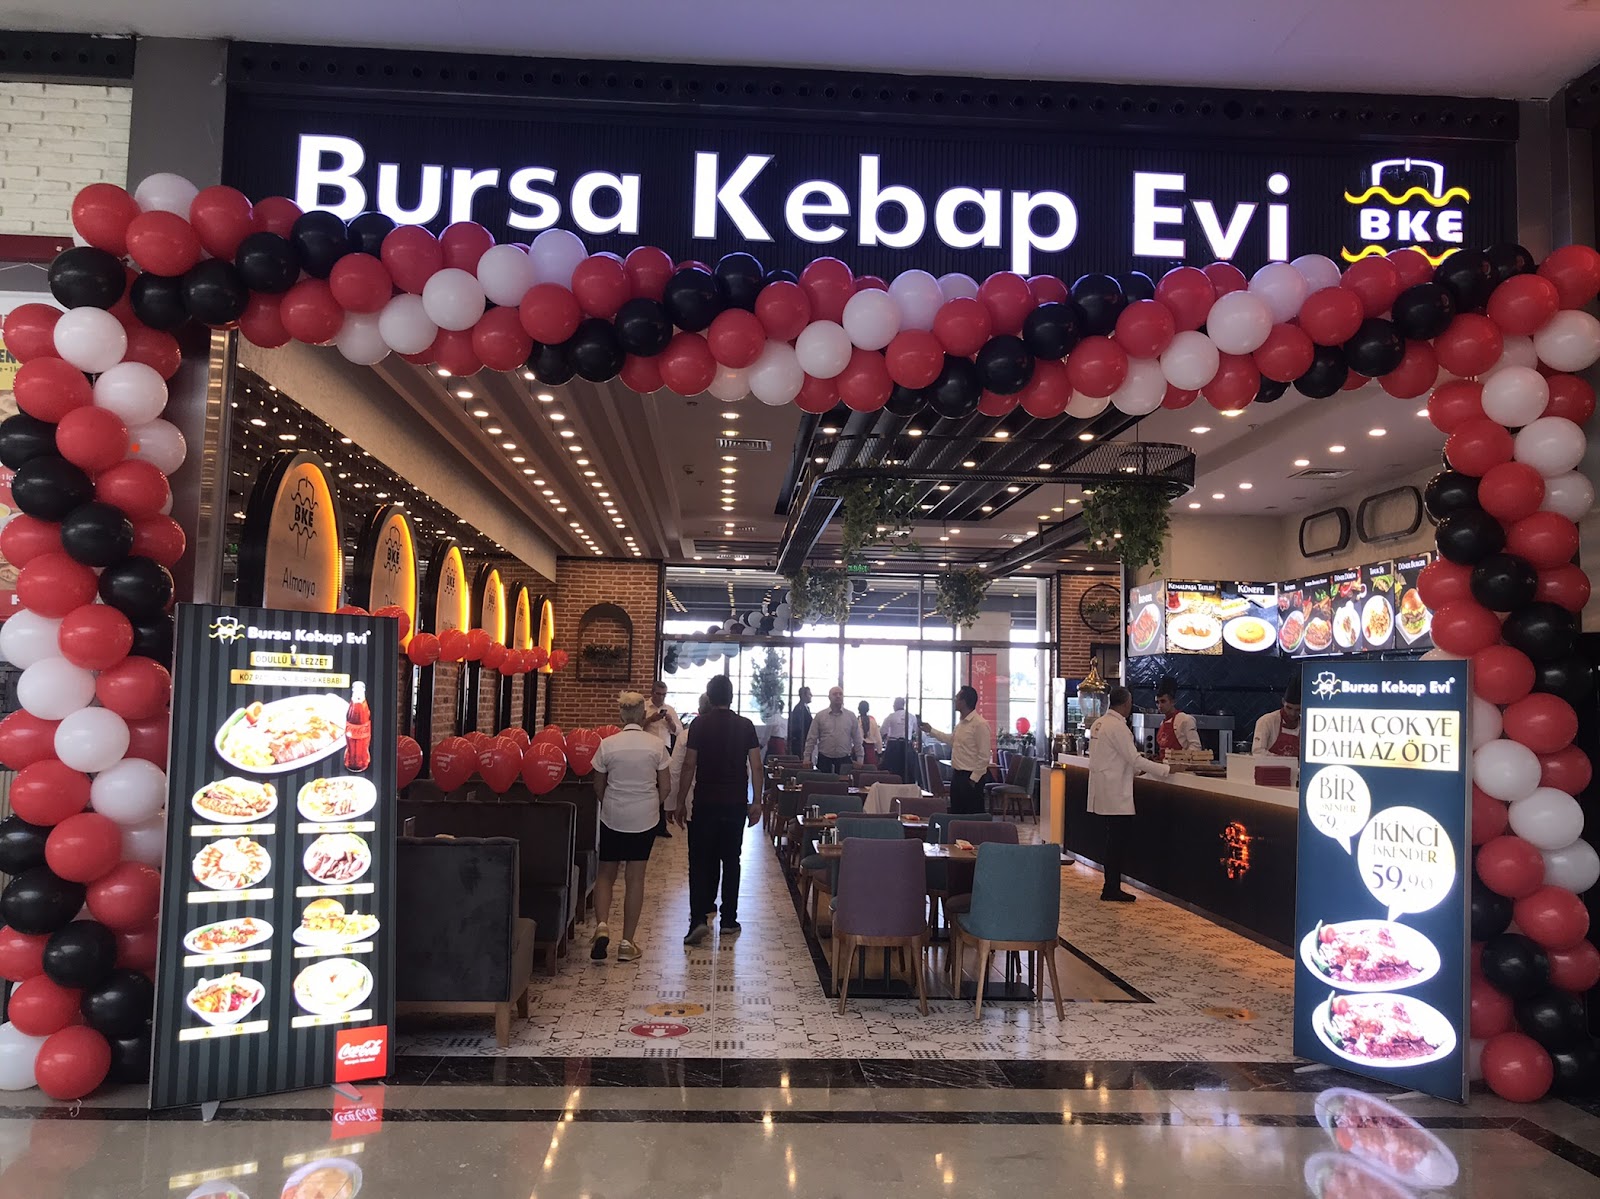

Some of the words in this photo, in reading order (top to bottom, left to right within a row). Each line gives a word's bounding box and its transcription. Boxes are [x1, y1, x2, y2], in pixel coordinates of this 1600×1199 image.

[295, 133, 642, 235] Bursa
[691, 150, 1079, 276] Kebap
[1132, 170, 1291, 263] Evi
[1359, 208, 1464, 243] BKE
[294, 504, 314, 528] BKE
[387, 548, 400, 564] BKE
[282, 568, 316, 598] Almanya
[1238, 585, 1264, 594] KÜNEFE
[247, 626, 291, 641] Bursa
[295, 629, 342, 646] Kebap
[346, 633, 367, 644] Evi
[1341, 681, 1378, 694] Bursa
[1382, 680, 1426, 696] Kebap
[1429, 680, 1450, 694] Evi
[1312, 714, 1366, 734] DAHA
[1371, 716, 1421, 738] ÇOK
[1426, 717, 1452, 737] YE
[1312, 738, 1366, 759] DAHA
[1370, 742, 1396, 761] AZ
[1402, 740, 1451, 763] ÖDE
[1320, 774, 1356, 802] BİR
[1374, 818, 1439, 847] İKİNCİ
